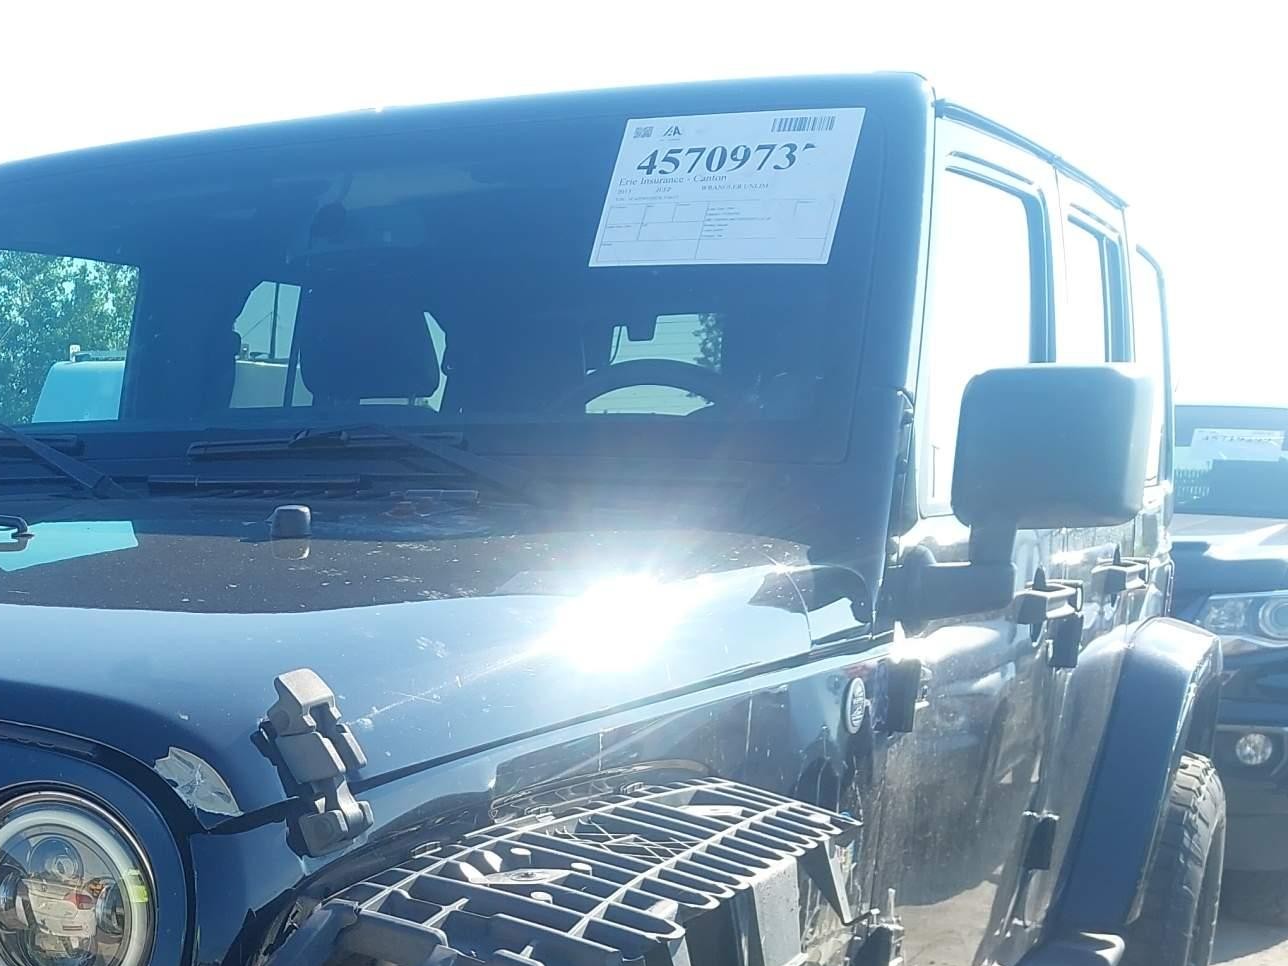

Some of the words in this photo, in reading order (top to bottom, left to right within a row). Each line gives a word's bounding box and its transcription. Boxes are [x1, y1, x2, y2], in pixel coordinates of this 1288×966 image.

[619, 177, 638, 186] Erie
[640, 175, 684, 185] Insurance
[693, 174, 727, 183] Canton
